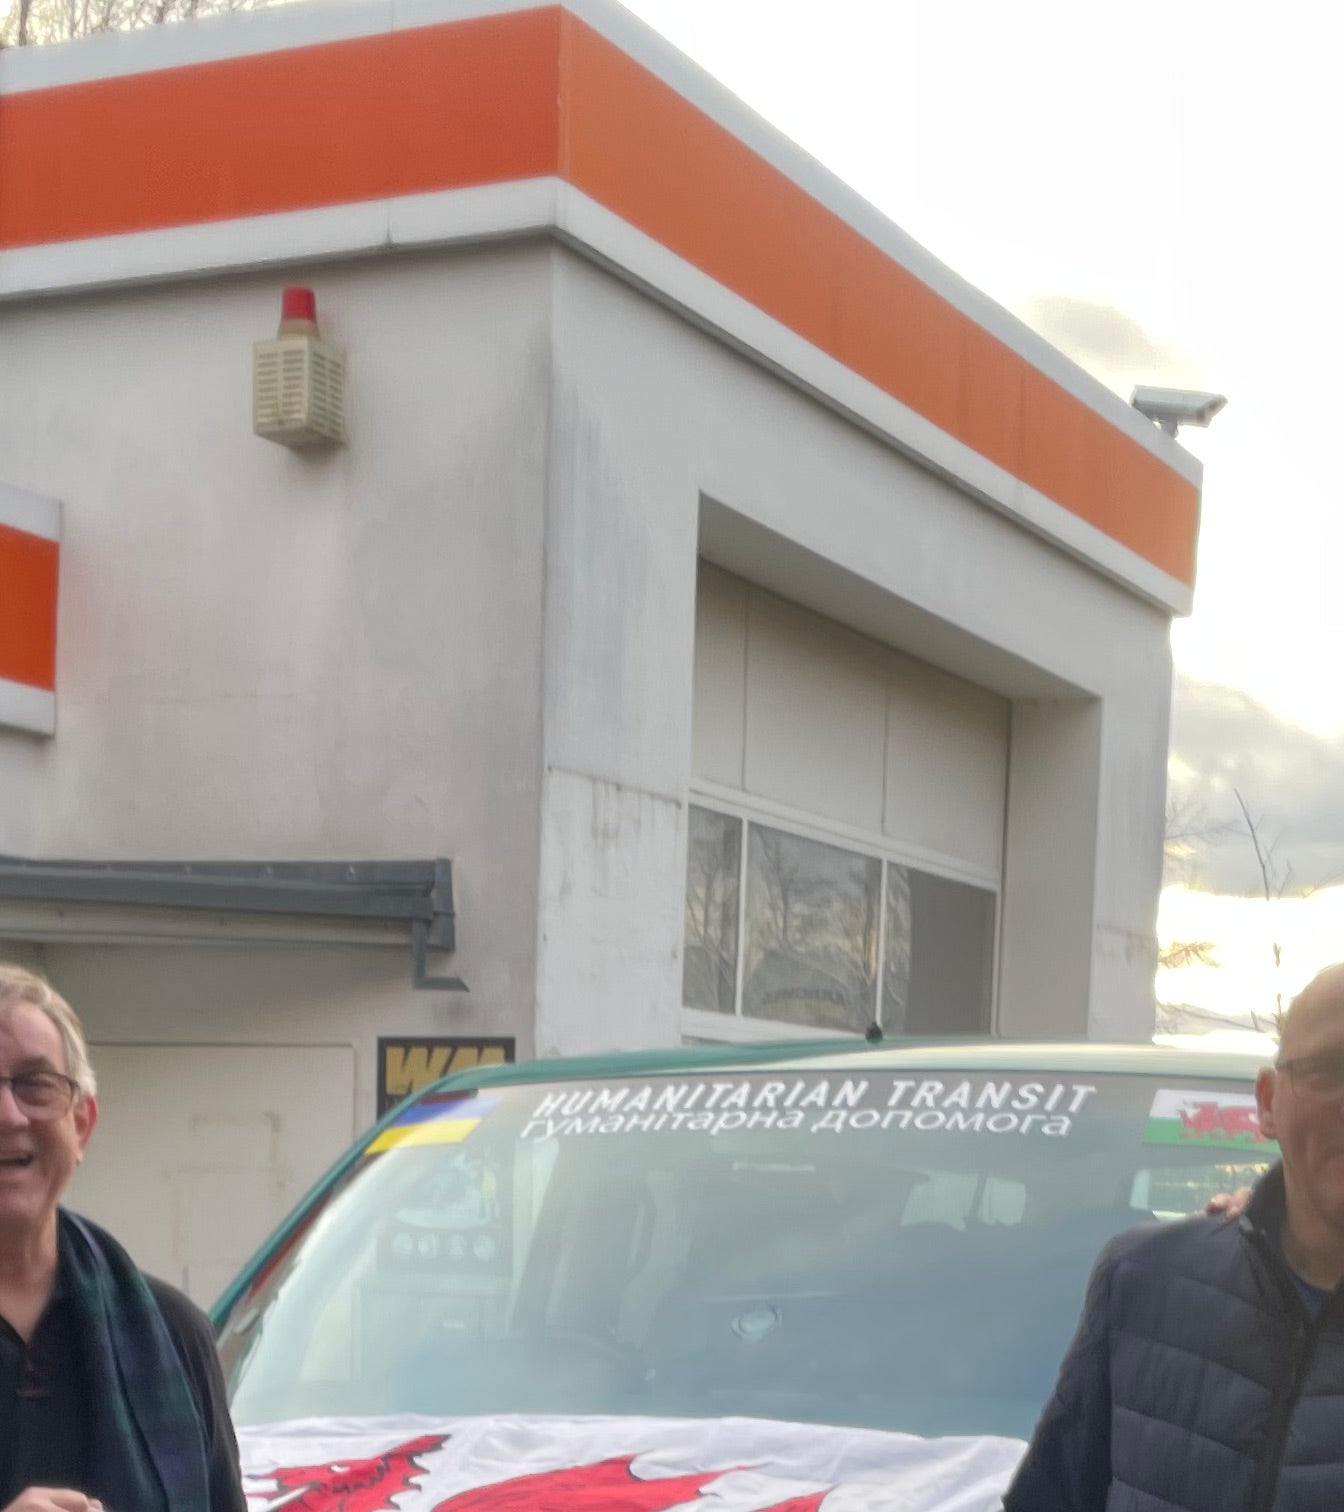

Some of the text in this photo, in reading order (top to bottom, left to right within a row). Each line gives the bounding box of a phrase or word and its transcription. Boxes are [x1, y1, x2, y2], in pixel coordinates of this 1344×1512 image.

[532, 1079, 1097, 1118] HUMANITARIAN TRANSIT
[520, 1109, 1073, 1143] гуманітарна допомога
